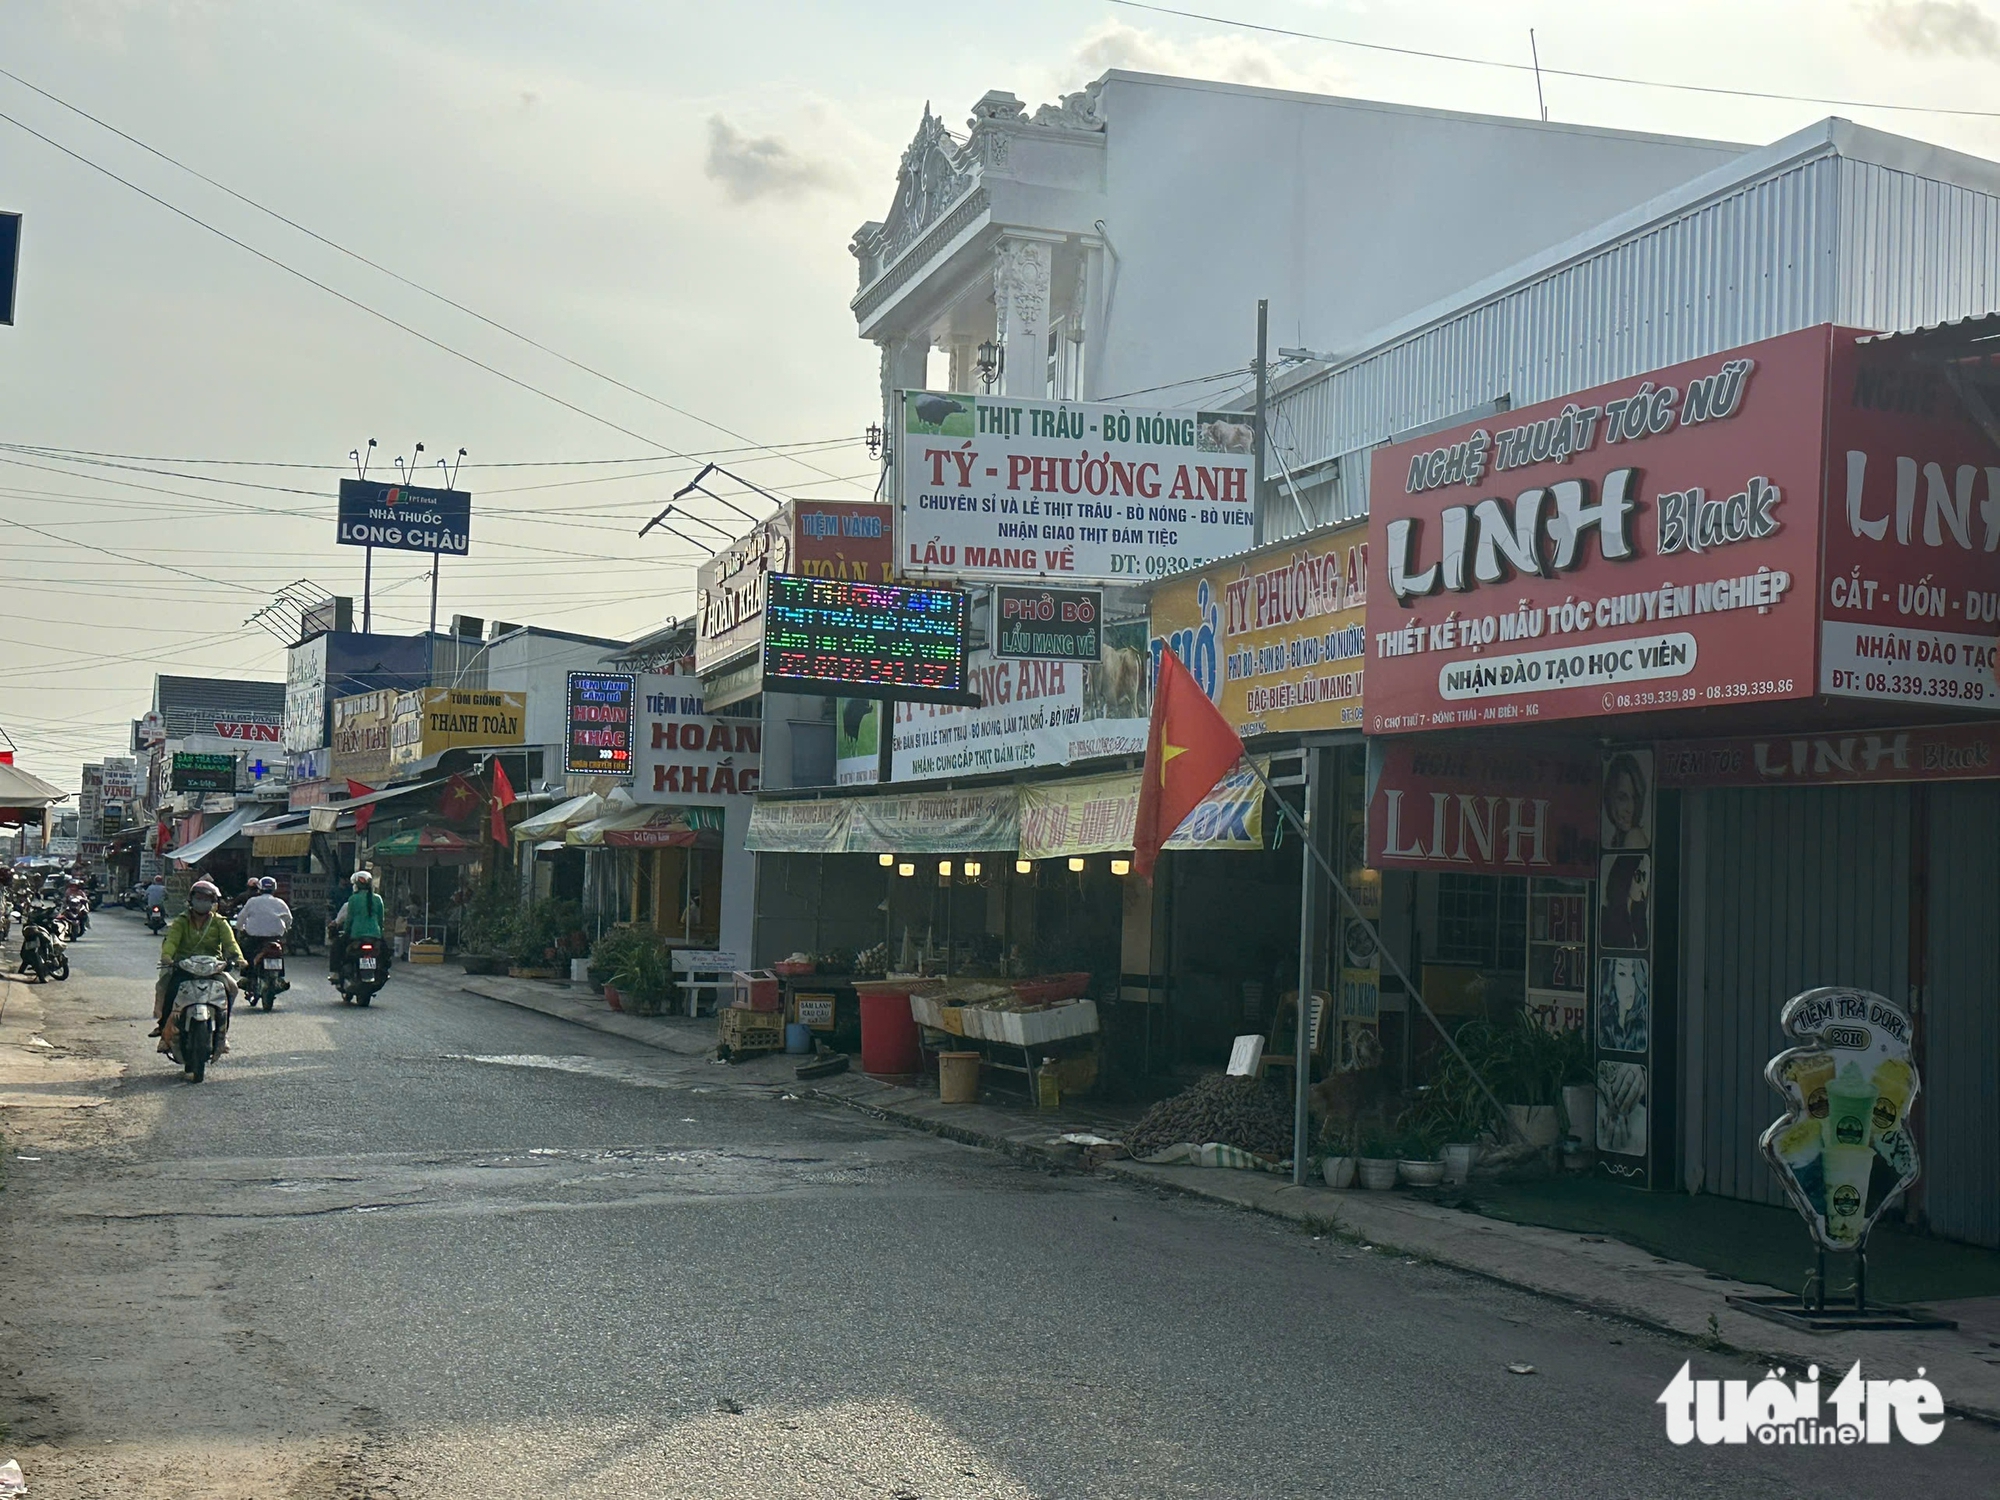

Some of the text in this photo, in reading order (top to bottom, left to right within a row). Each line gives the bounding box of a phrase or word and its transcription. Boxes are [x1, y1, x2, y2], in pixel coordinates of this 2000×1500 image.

[976, 405, 1025, 440] THỊT
[1029, 405, 1085, 440] TRÂU
[1103, 409, 1131, 445] BÒ
[1136, 411, 1195, 447] NÓNG
[1405, 358, 1755, 495] NGHỆ THUẬT TÓC NỮ
[924, 440, 979, 488] TÝ
[1006, 449, 1162, 500] PHƯƠNG
[1168, 464, 1248, 503] ANH
[369, 508, 442, 525] NHÀ THUỐC
[919, 493, 1254, 526] CHUYÊN SỈ VÀ LẺ THỊT TRÂU BÒ NÓNG BÒ VIÊN
[341, 523, 467, 550] LONG CHÂU
[801, 511, 882, 541] TIỆM VÀNG
[998, 522, 1178, 546] NHẬN GIAO THỊT ĐÁM TIỆC
[1386, 467, 1782, 600] LINH Black
[910, 535, 1075, 571] LẨU MANG VỀ
[1110, 553, 1141, 575] ĐT:
[1224, 549, 1338, 636] TÝ PHƯƠNG
[1831, 566, 1879, 611] CẮT
[1897, 574, 1947, 617] UỐN
[1003, 592, 1096, 624] PHỞ BÒ
[1376, 566, 1790, 659] THIẾT KẾ TẠO MẪU TÓC CHUYÊN NGHIỆP
[1002, 621, 1096, 656] LẨU MANG VỀ
[1855, 635, 1911, 667] NHẬN
[1916, 639, 1956, 667] ĐÀO
[1016, 658, 1065, 701] ANH
[1446, 641, 1687, 694] NHẬN ĐÀO TẠO HỌC VIÊN
[451, 690, 501, 707] TÔM GIỐNG
[1318, 674, 1353, 702] MANG
[1705, 679, 1794, 700] 08.339.339.86
[1832, 668, 1984, 701] ĐT: 08.339.339.89
[573, 703, 627, 724] HOÀN
[646, 692, 677, 716] TIỆM
[1384, 704, 1540, 729] CHỢ THỨ 7 ĐÔNG THÁI AN BIÊN KG
[214, 722, 282, 743] VIN
[430, 712, 518, 735] THANH TOÀN
[573, 725, 625, 747] KHẮC
[651, 717, 761, 754] HOÀN
[1753, 734, 1911, 776] LINH
[652, 756, 760, 795] KHẮC
[1381, 788, 1552, 867] LINH
[1836, 995, 1868, 1020] TRÀ
